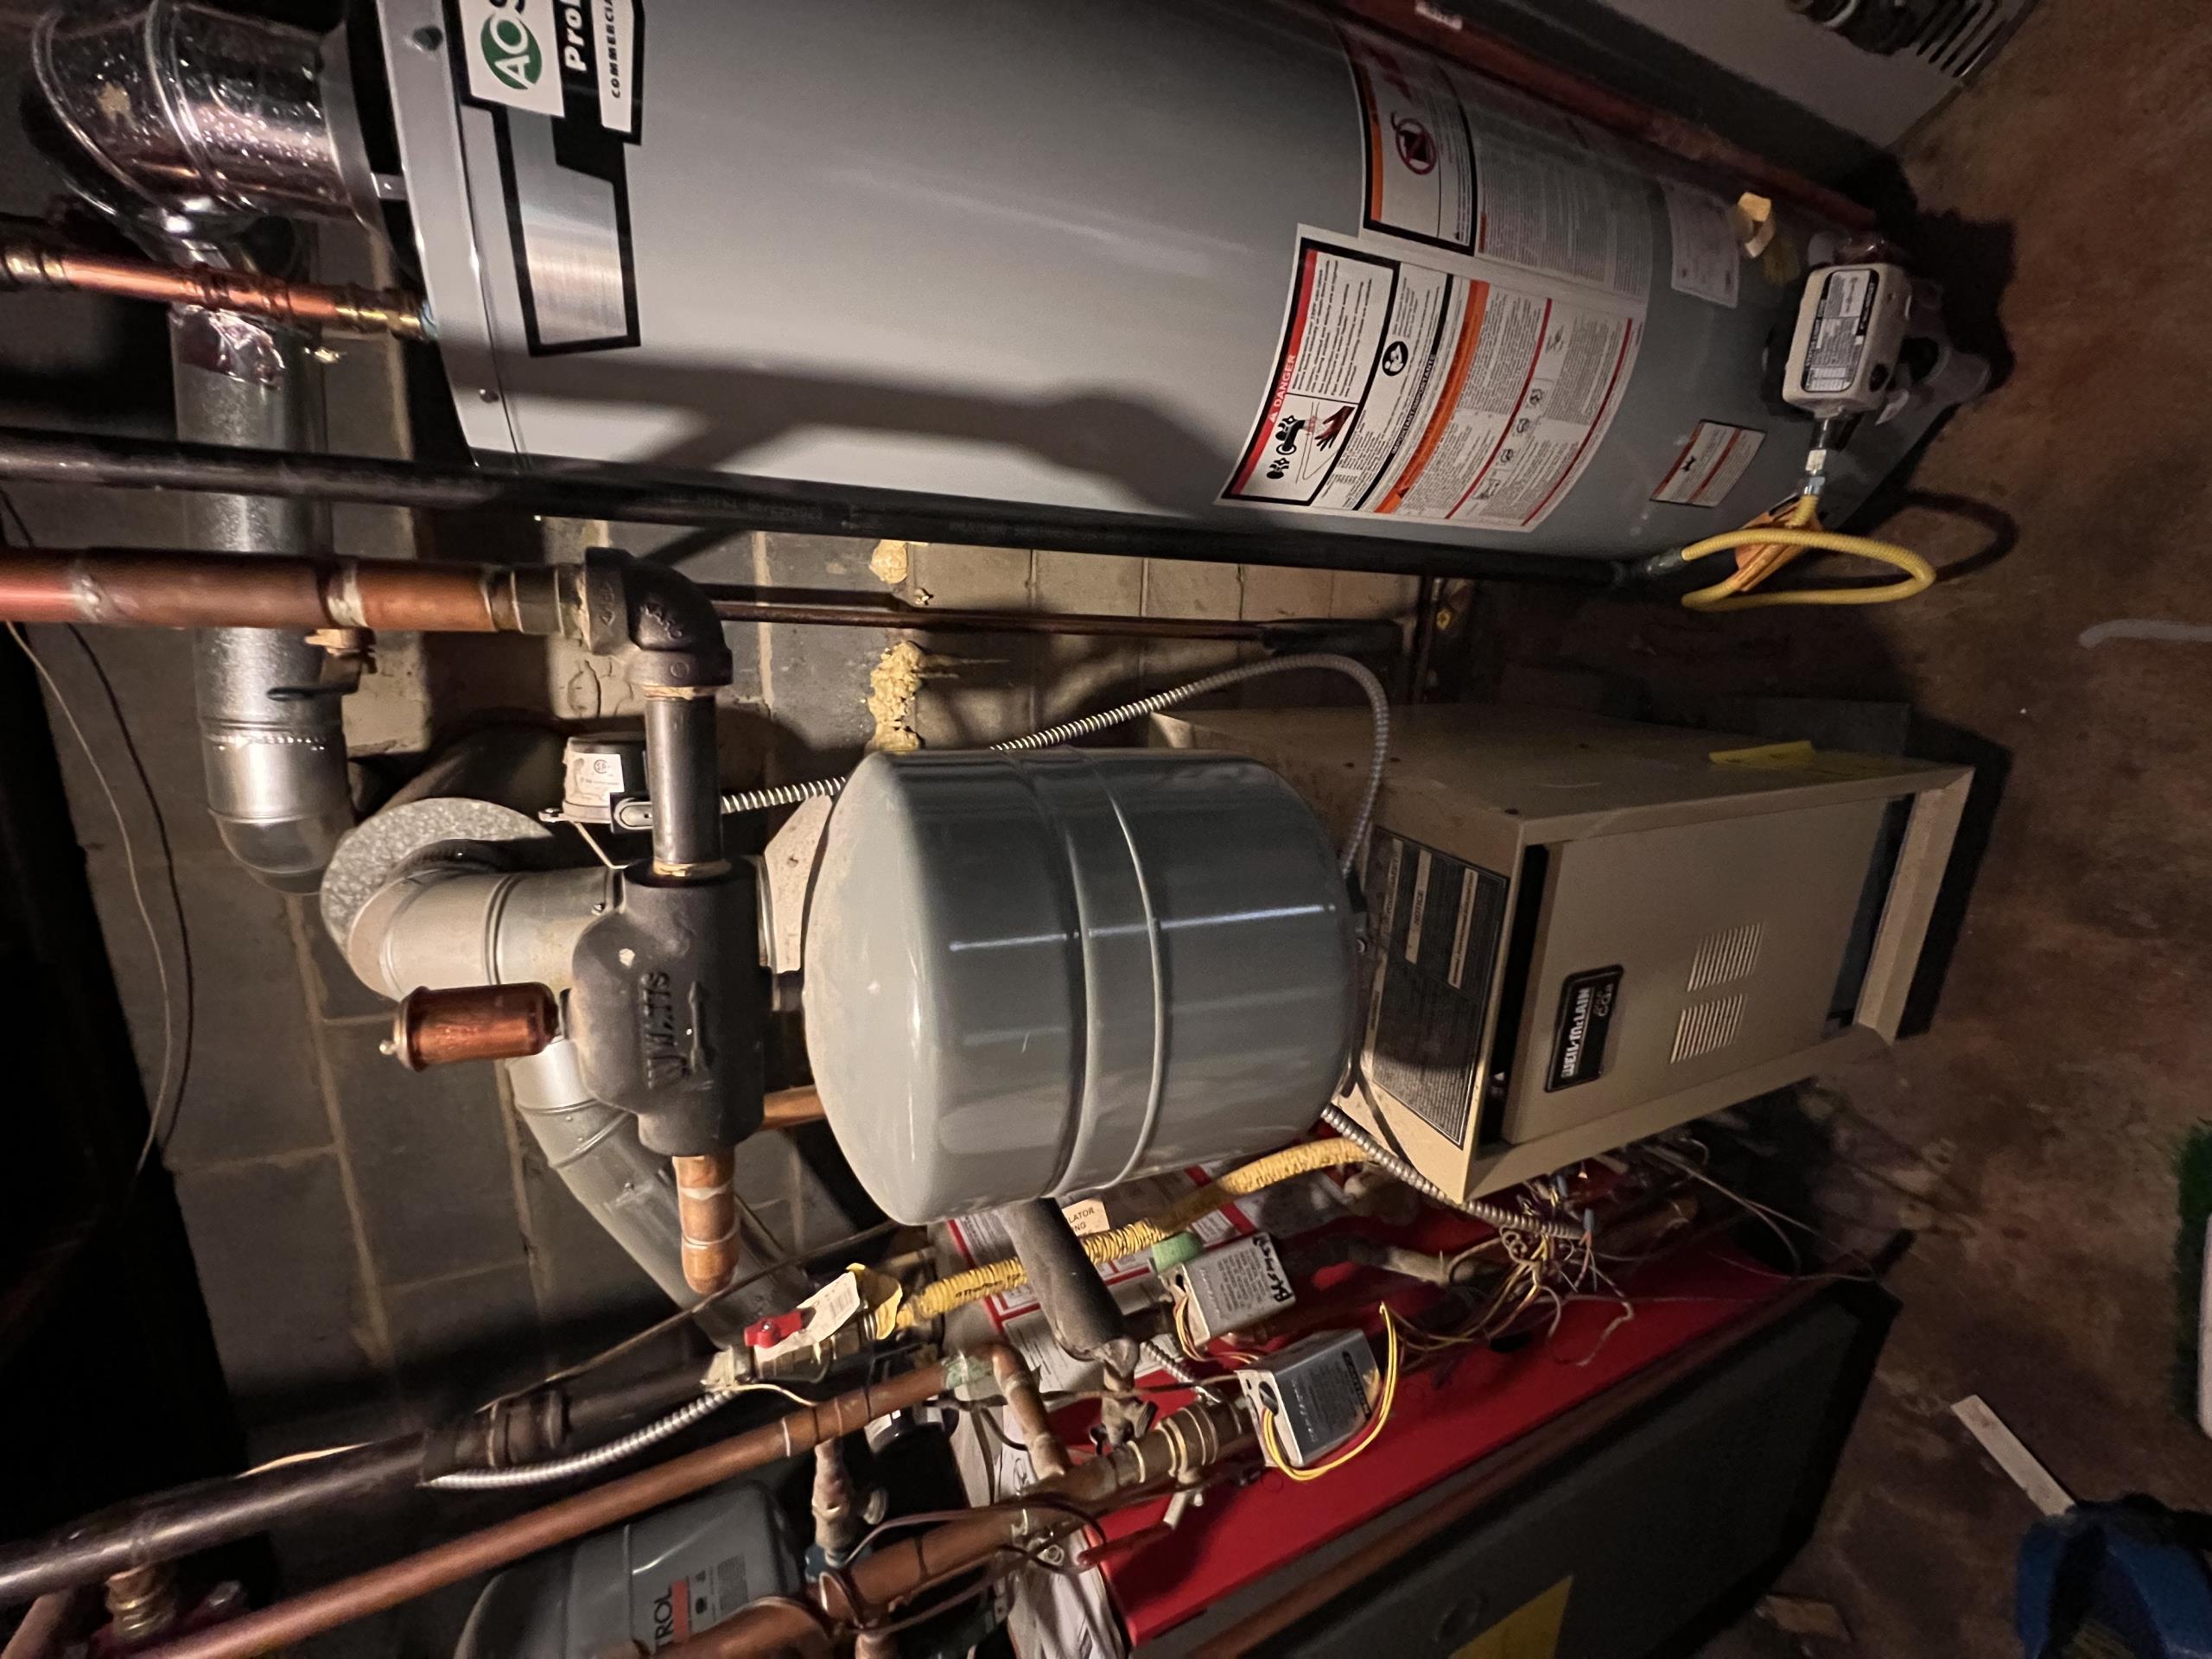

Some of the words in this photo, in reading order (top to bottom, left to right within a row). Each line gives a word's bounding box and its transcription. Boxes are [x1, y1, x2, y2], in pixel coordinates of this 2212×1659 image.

[1273, 354, 1296, 406] DANGER
[1414, 889, 1424, 925] NOTICE
[640, 972, 675, 1053] WATTS
[1068, 1206, 1095, 1224] LATOR
[1072, 1222, 1087, 1232] NG
